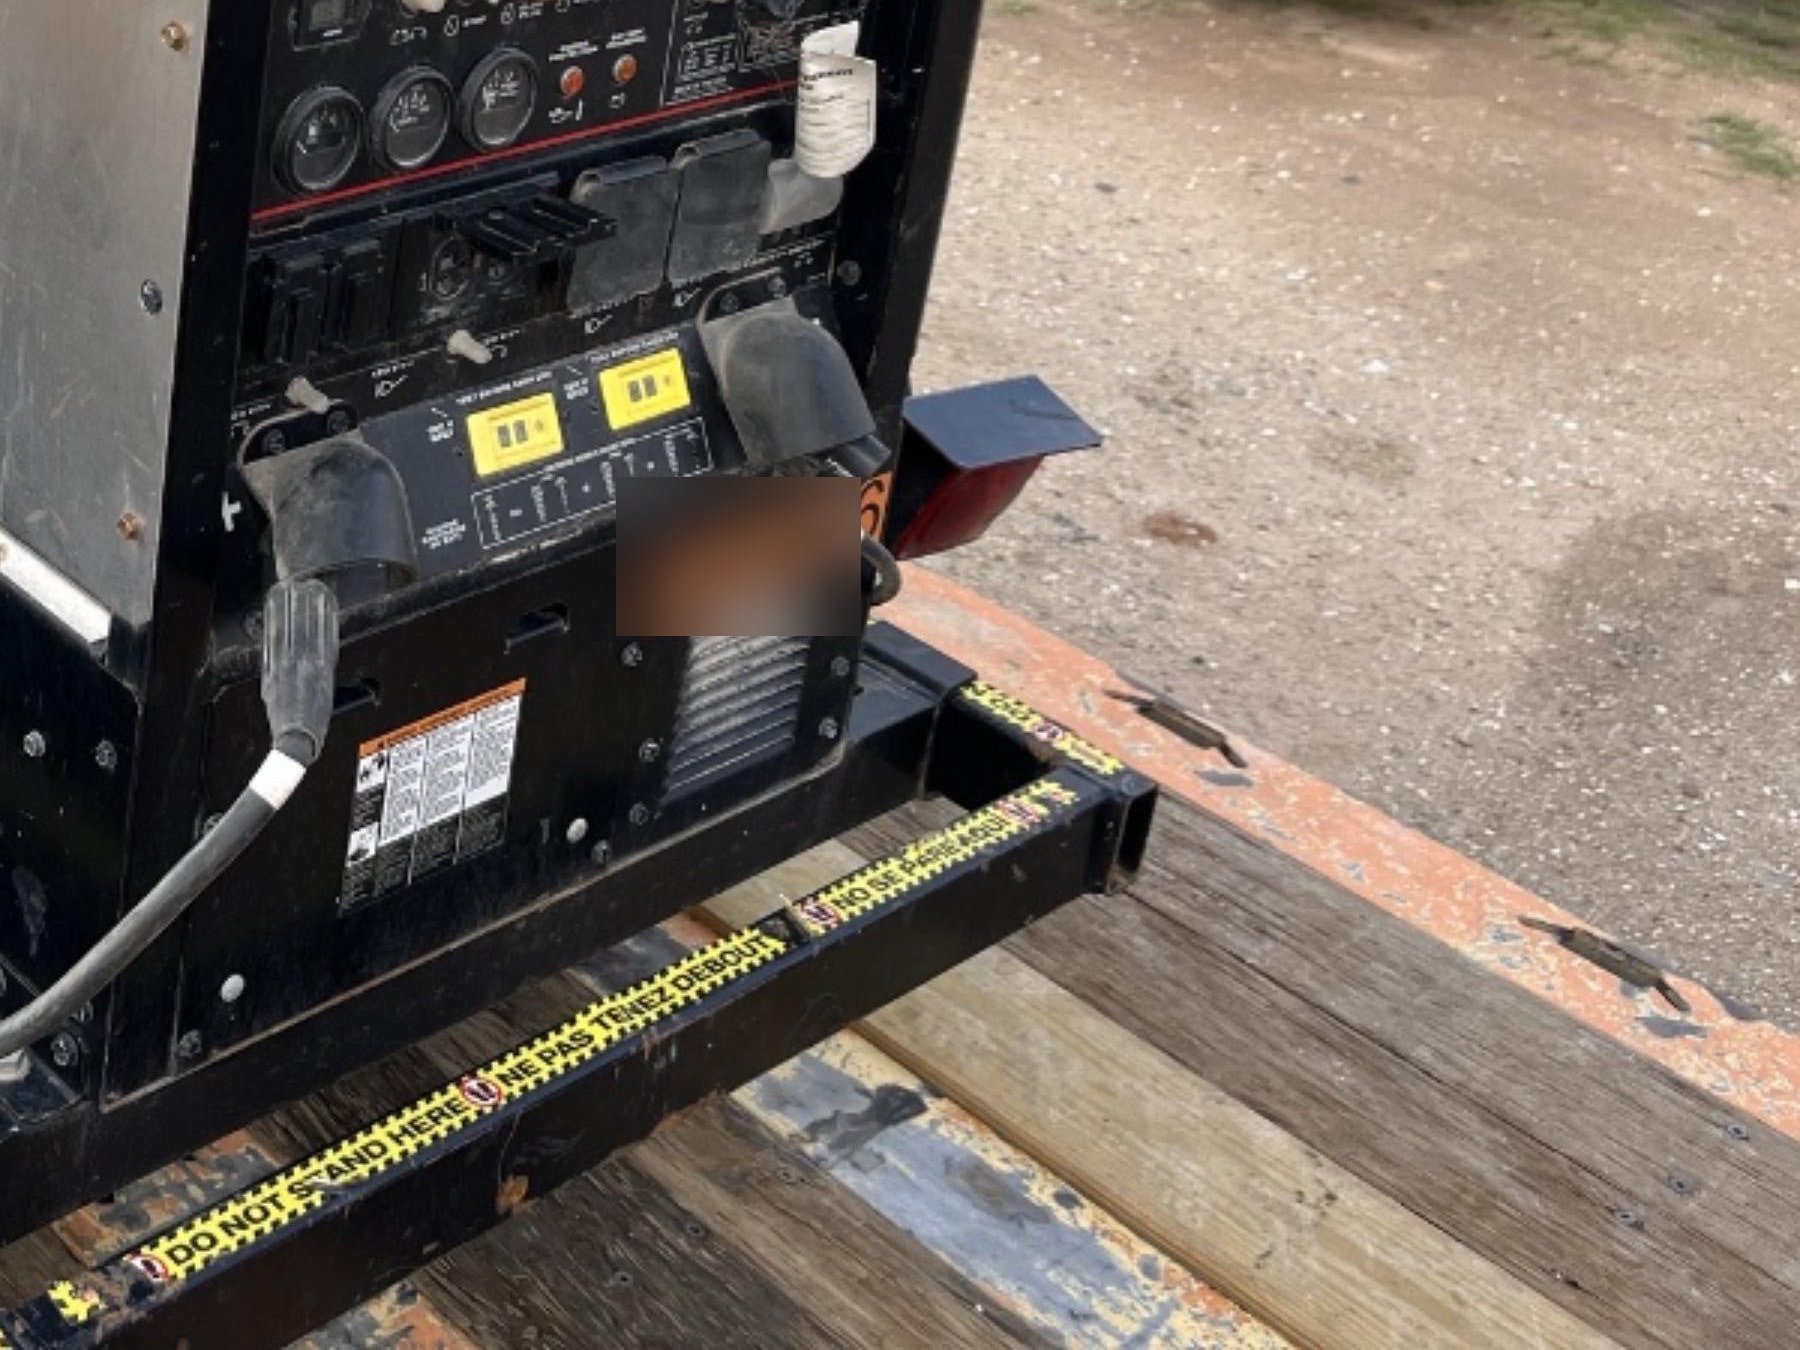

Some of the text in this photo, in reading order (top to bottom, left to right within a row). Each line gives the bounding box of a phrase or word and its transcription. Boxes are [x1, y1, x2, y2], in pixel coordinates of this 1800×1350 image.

[495, 934, 774, 1088] NE PAS TENEZ DEBOUT
[165, 1231, 218, 1268] DO
[218, 1194, 291, 1236] NOT
[389, 1096, 468, 1146] HERE
